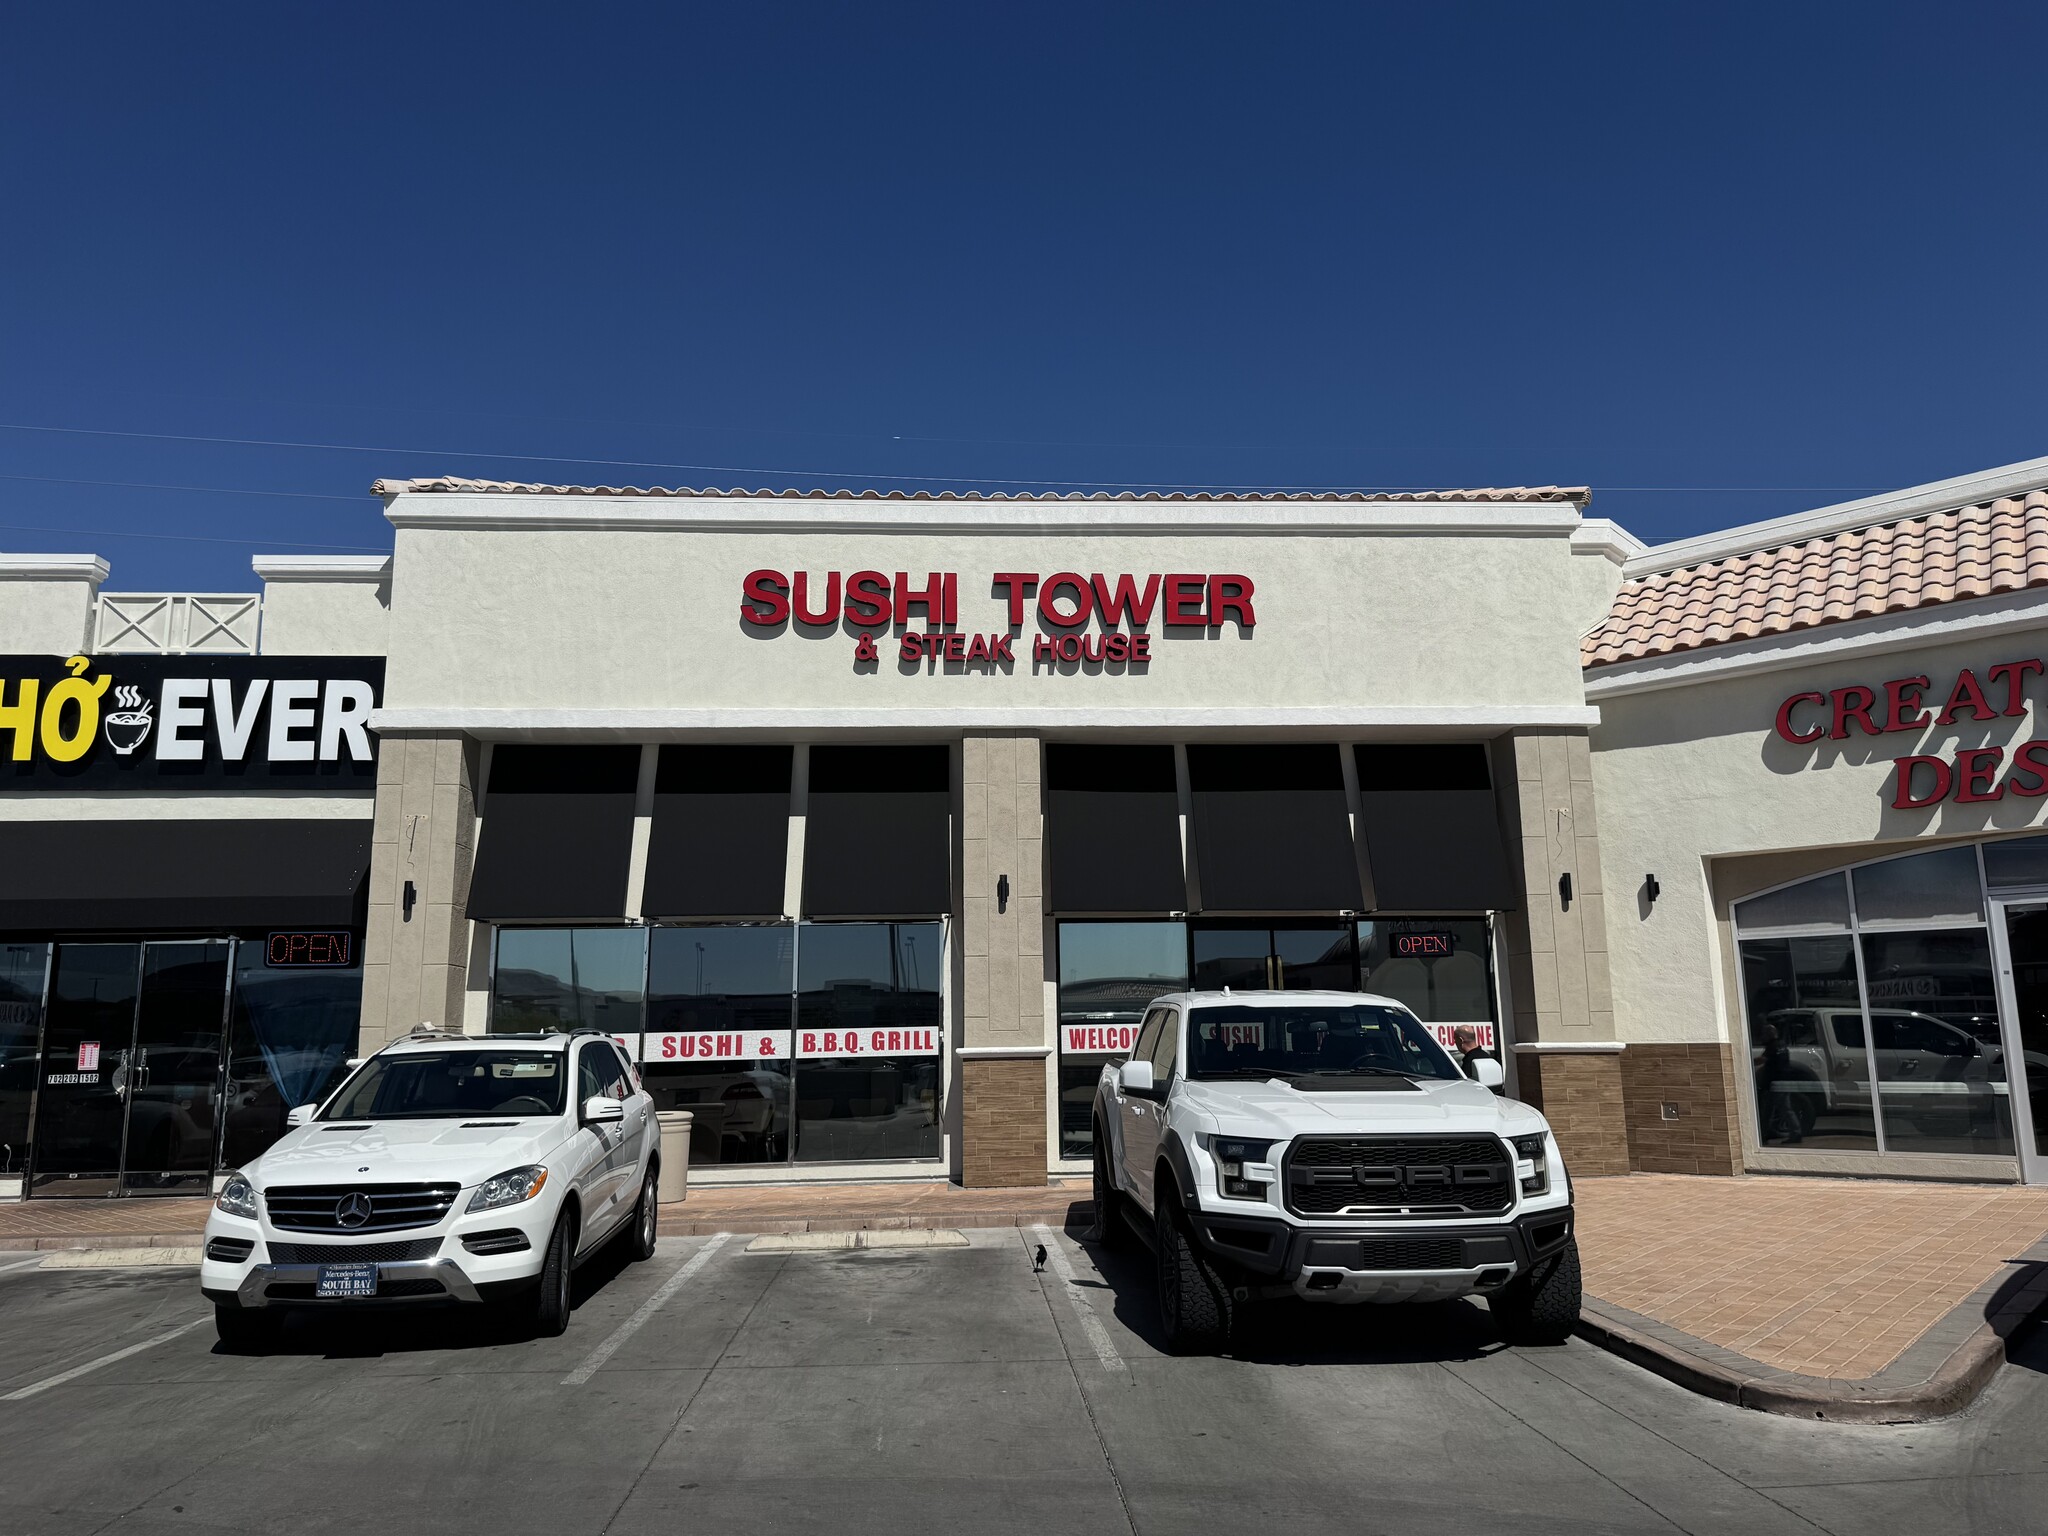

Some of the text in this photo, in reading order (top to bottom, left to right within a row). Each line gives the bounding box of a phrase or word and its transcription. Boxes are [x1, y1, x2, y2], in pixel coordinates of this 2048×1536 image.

[740, 569, 1256, 627] SUSHI TOWER
[854, 632, 1152, 662] & STEAK HOUSE
[1775, 658, 2048, 744] CREAT
[155, 678, 375, 761] EVER
[1891, 740, 2048, 809] DES
[270, 934, 347, 962] OPEN
[1399, 936, 1447, 953] OPEN
[662, 1030, 934, 1059] SUSHI & B.B.Q. GRILL
[1069, 1027, 1139, 1049] WELCO
[1438, 1025, 1493, 1047] CUNE
[48, 1074, 99, 1084] 702 202 1502
[1298, 1163, 1503, 1186] FORD
[321, 1279, 371, 1289] SOUTH BAY
